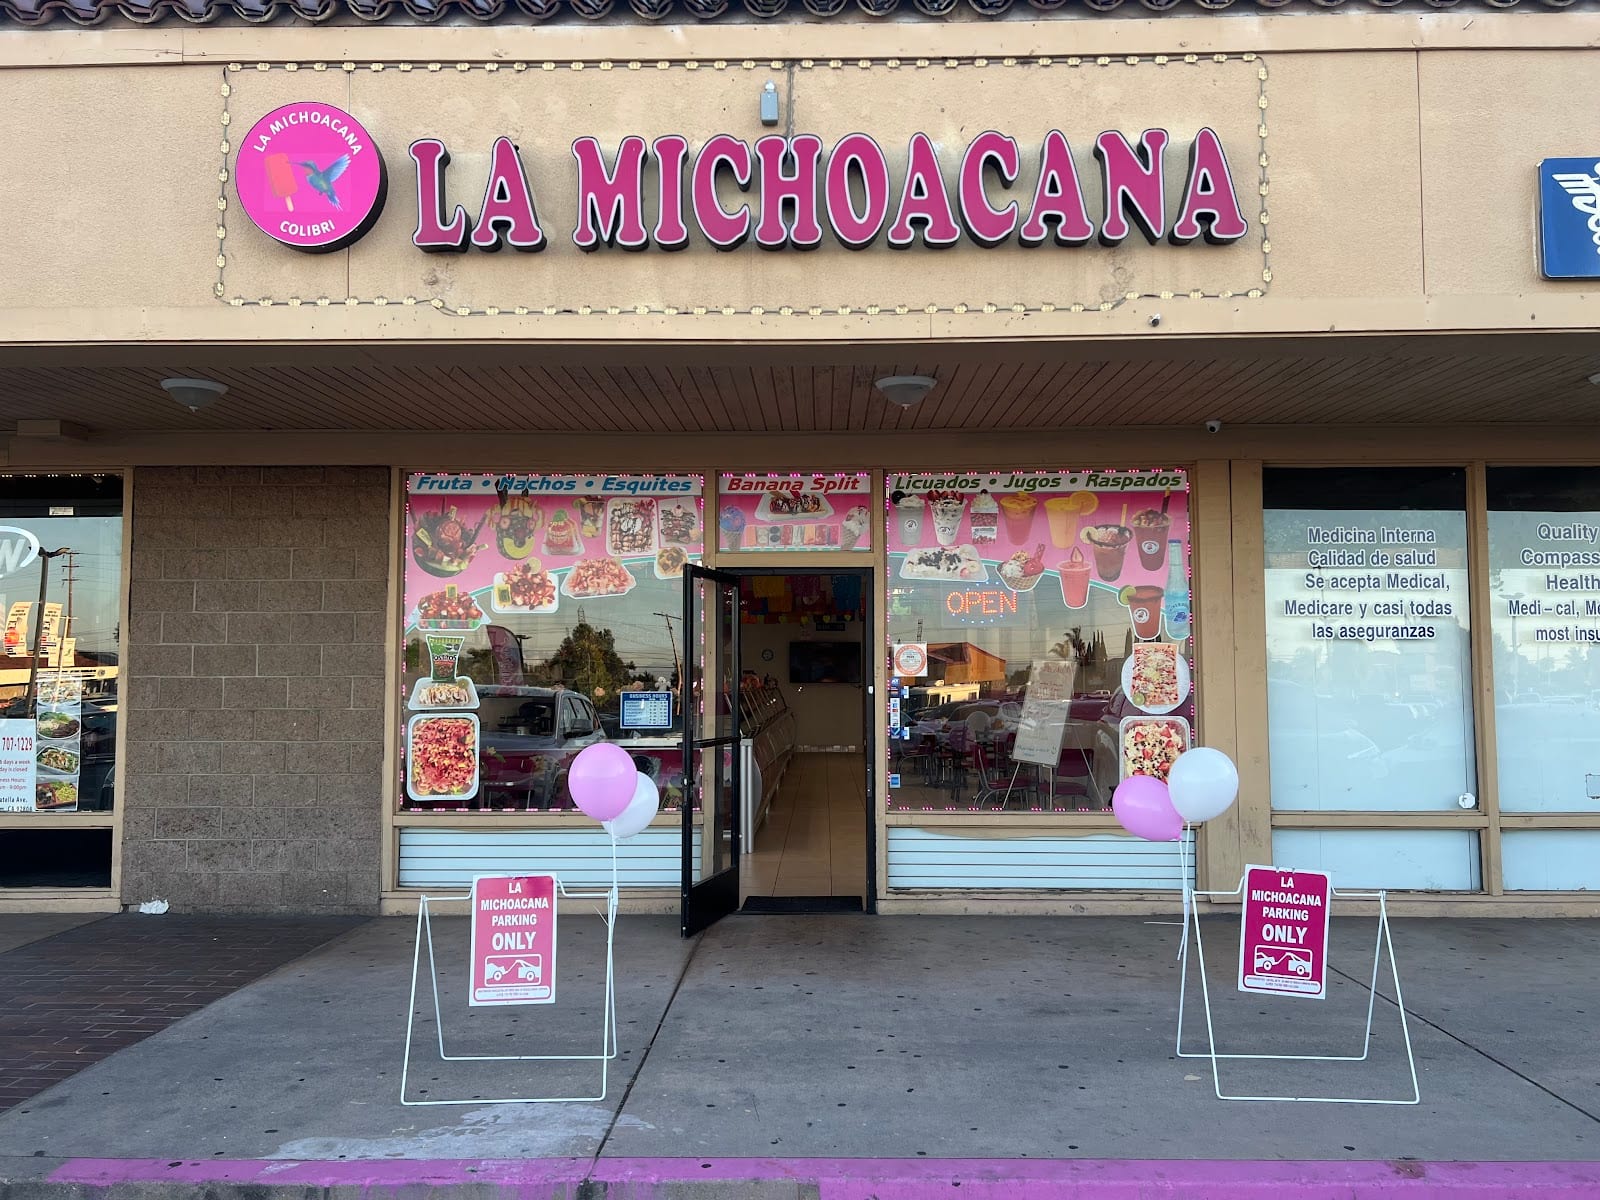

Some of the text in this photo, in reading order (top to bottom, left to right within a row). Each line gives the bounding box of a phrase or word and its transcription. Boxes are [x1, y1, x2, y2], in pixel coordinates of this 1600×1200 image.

[253, 111, 362, 155] LA MICHOACANA
[409, 126, 1248, 251] LA MICHOACANA
[280, 219, 335, 236] COLIBRI
[416, 476, 692, 494] Fruta Nachos Esquites
[728, 476, 860, 493] Banana Split
[895, 473, 1182, 491] Licuados Jugos Raspados
[1308, 526, 1435, 543] Medicina Interna
[1537, 523, 1598, 544] Quality
[1308, 550, 1436, 566] Calidad de salud
[1305, 573, 1450, 592] Se acepta Medical,
[947, 591, 1017, 614] OPEN
[1284, 599, 1452, 619] Medicare y casi todas
[1312, 623, 1435, 642] las aseguranzas
[1536, 626, 1570, 642] most
[2, 737, 33, 751] 707-1229
[508, 882, 522, 894] LA
[1280, 876, 1295, 889] LA
[480, 897, 549, 911] MICHOACANA
[1252, 889, 1322, 907] MICHOACANA
[491, 914, 537, 927] PARKING
[1262, 906, 1309, 922] PARKING
[491, 931, 536, 951] ONLY
[1262, 923, 1308, 945] ONLY
